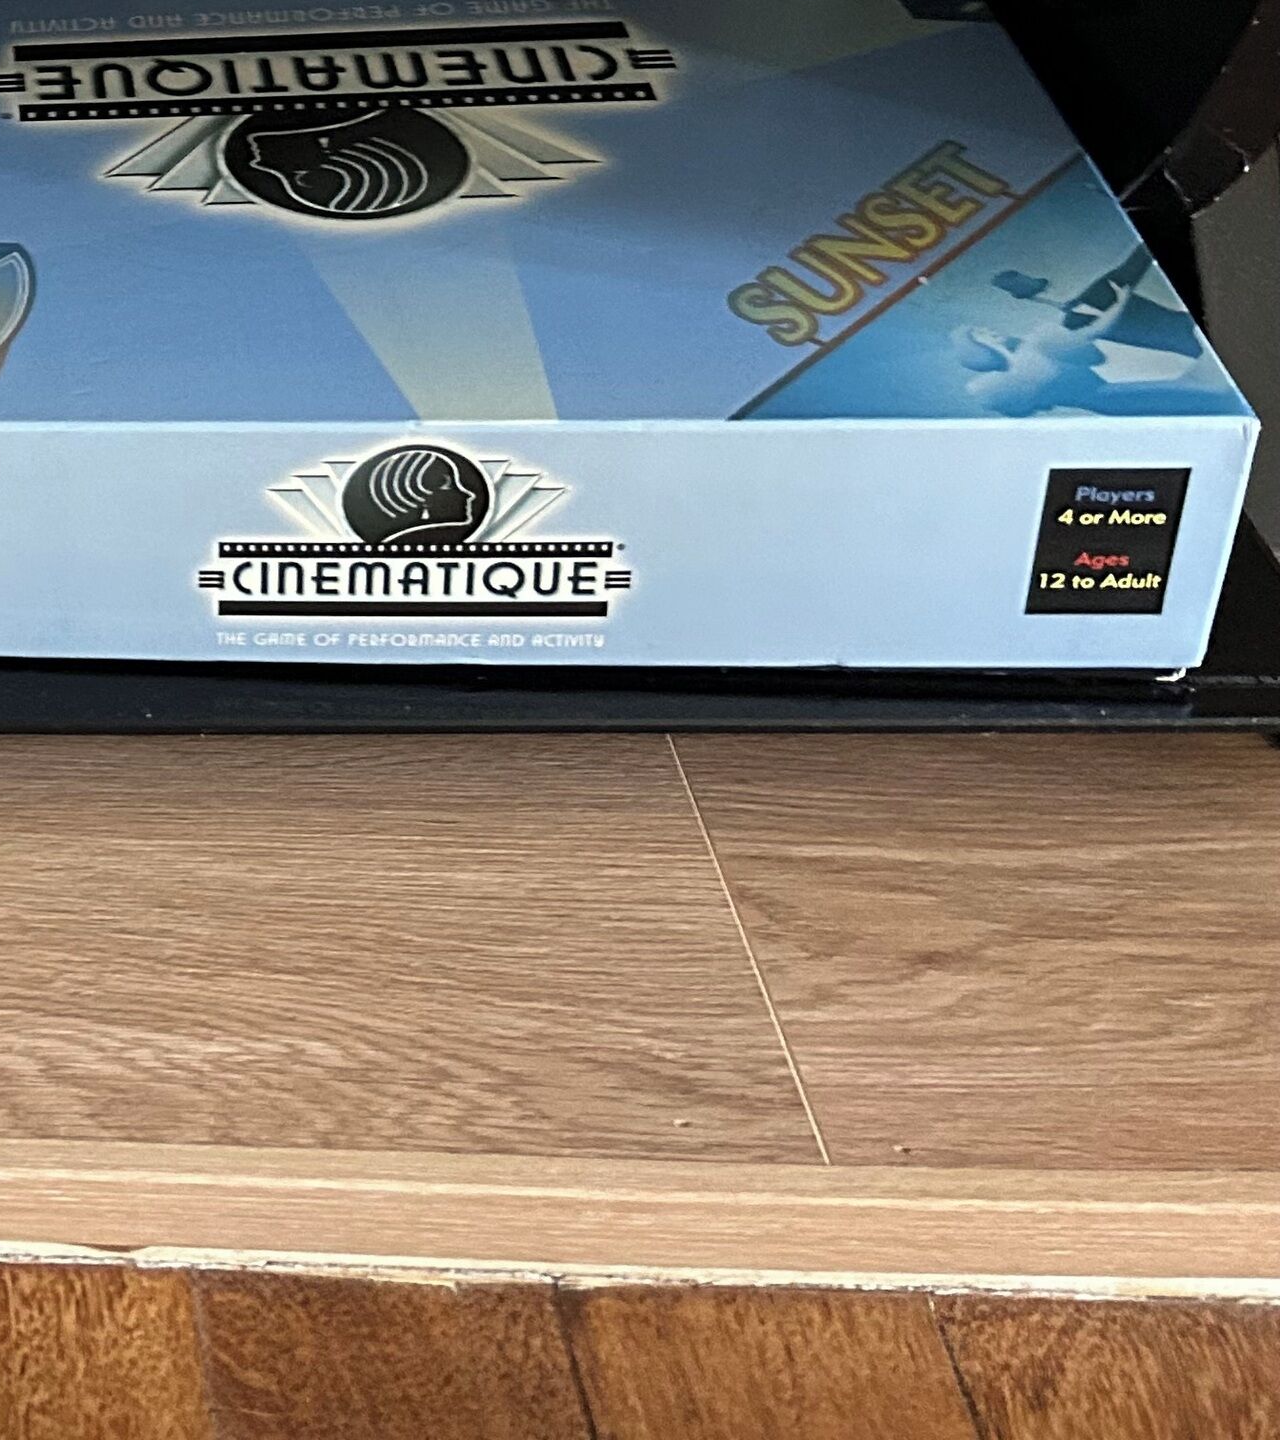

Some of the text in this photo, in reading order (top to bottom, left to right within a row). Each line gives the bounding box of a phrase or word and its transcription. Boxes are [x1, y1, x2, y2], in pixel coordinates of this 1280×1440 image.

[198, 5, 401, 28] PERFORMANCE
[417, 2, 455, 16] OF
[8, 17, 116, 34] ACTIVITY
[128, 13, 183, 30] AND
[36, 44, 618, 100] CINEMATIQUE
[726, 139, 1011, 347] SUNSET
[1074, 485, 1156, 505] Players
[1057, 508, 1167, 525] 4 or More
[1074, 551, 1131, 570] Ages
[232, 560, 598, 599] CINEMATIQUE
[1039, 573, 1162, 589] 12 to Adult
[216, 631, 605, 649] THE GAME OF PERFORMANCE AND ACTIVITY
